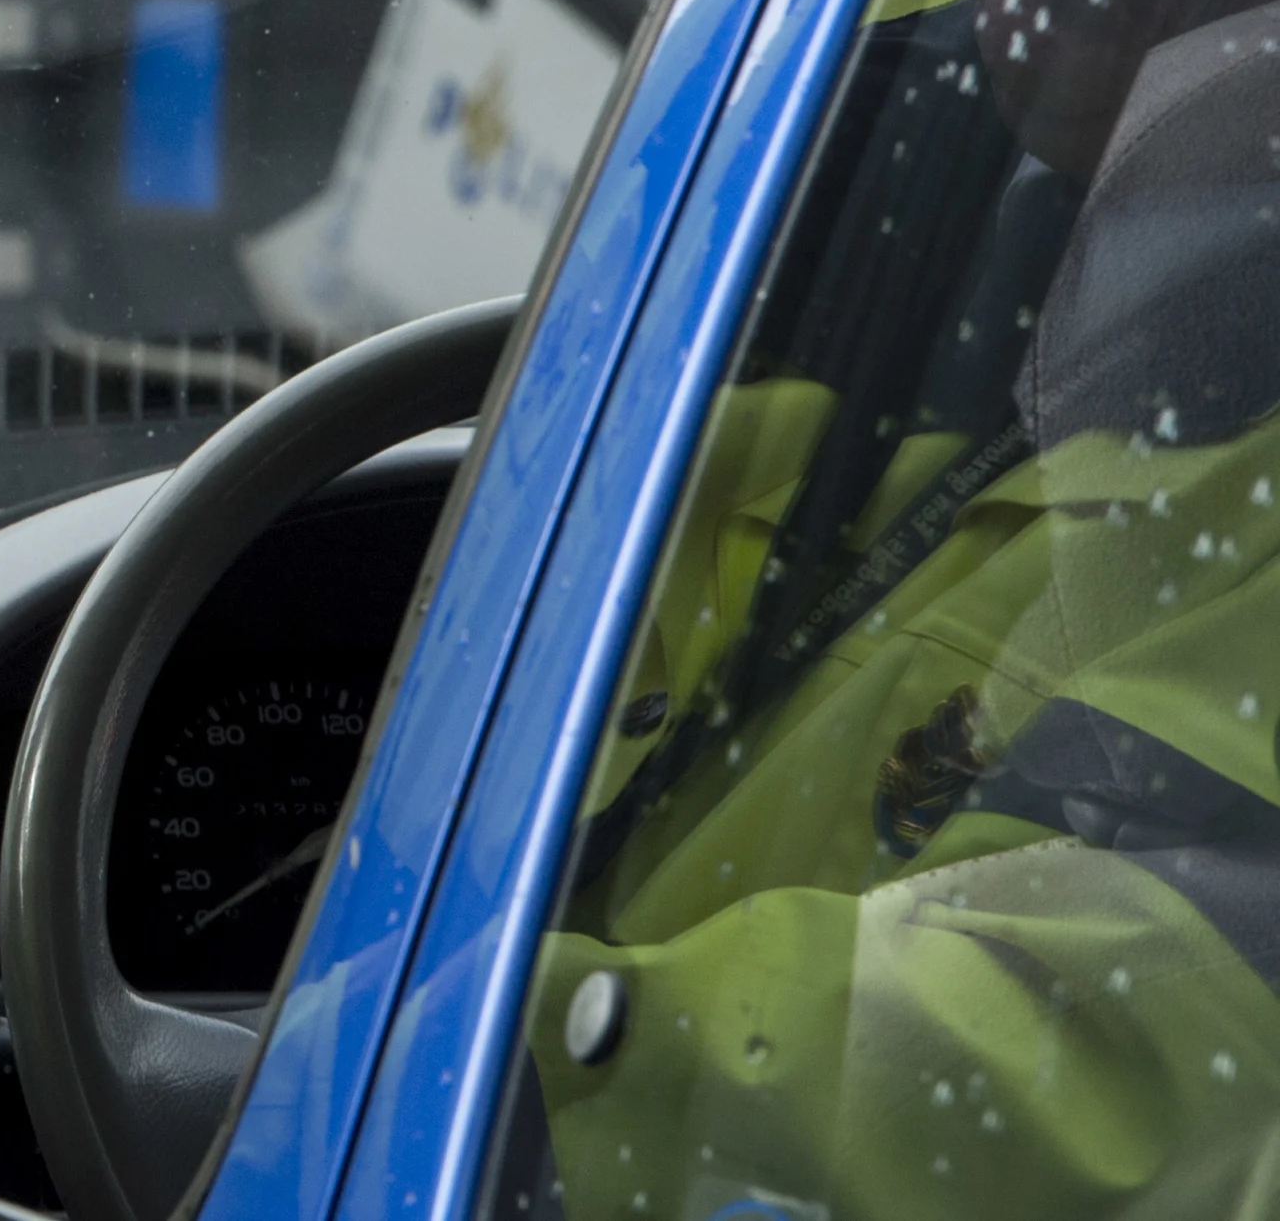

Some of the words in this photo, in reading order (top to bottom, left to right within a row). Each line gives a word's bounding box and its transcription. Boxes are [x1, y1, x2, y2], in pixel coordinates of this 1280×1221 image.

[258, 703, 303, 724] 100
[206, 724, 246, 746] 80
[321, 714, 364, 736] 120
[176, 765, 215, 788] 60
[163, 817, 201, 839] 40
[175, 868, 212, 891] 20
